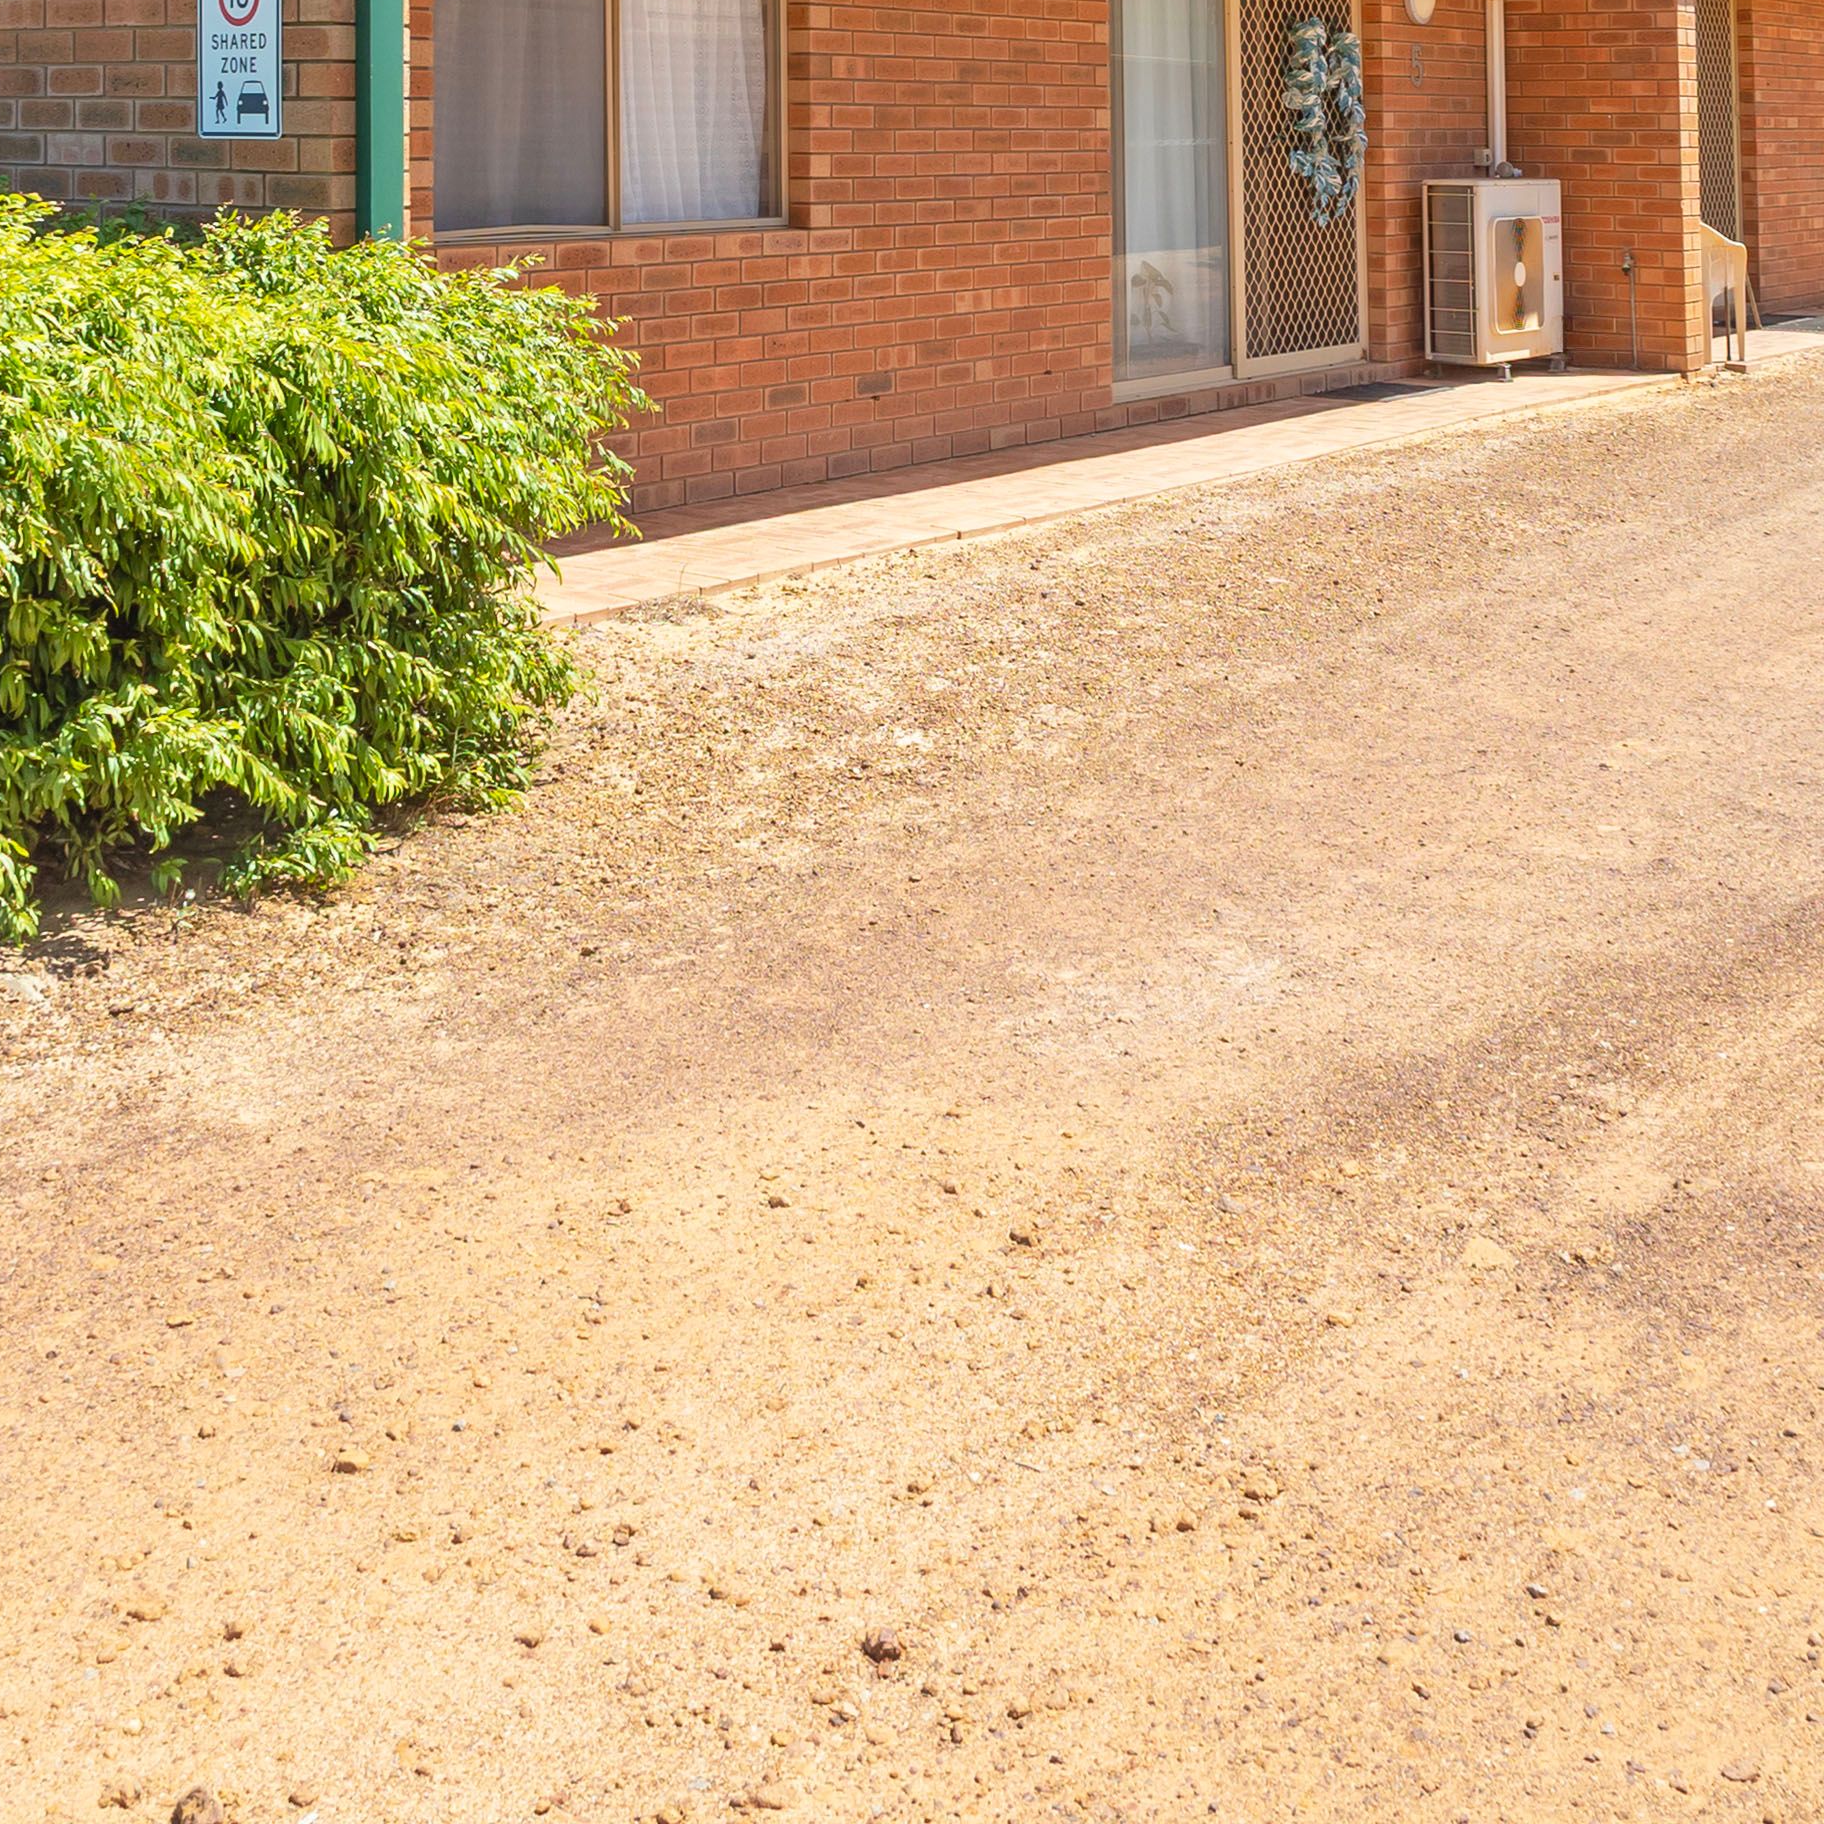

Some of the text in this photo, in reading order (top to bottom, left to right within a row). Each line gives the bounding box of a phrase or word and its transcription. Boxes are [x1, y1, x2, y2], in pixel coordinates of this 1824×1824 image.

[211, 33, 267, 52] SHARED
[221, 56, 257, 75] ZONE
[1410, 43, 1424, 87] 5
